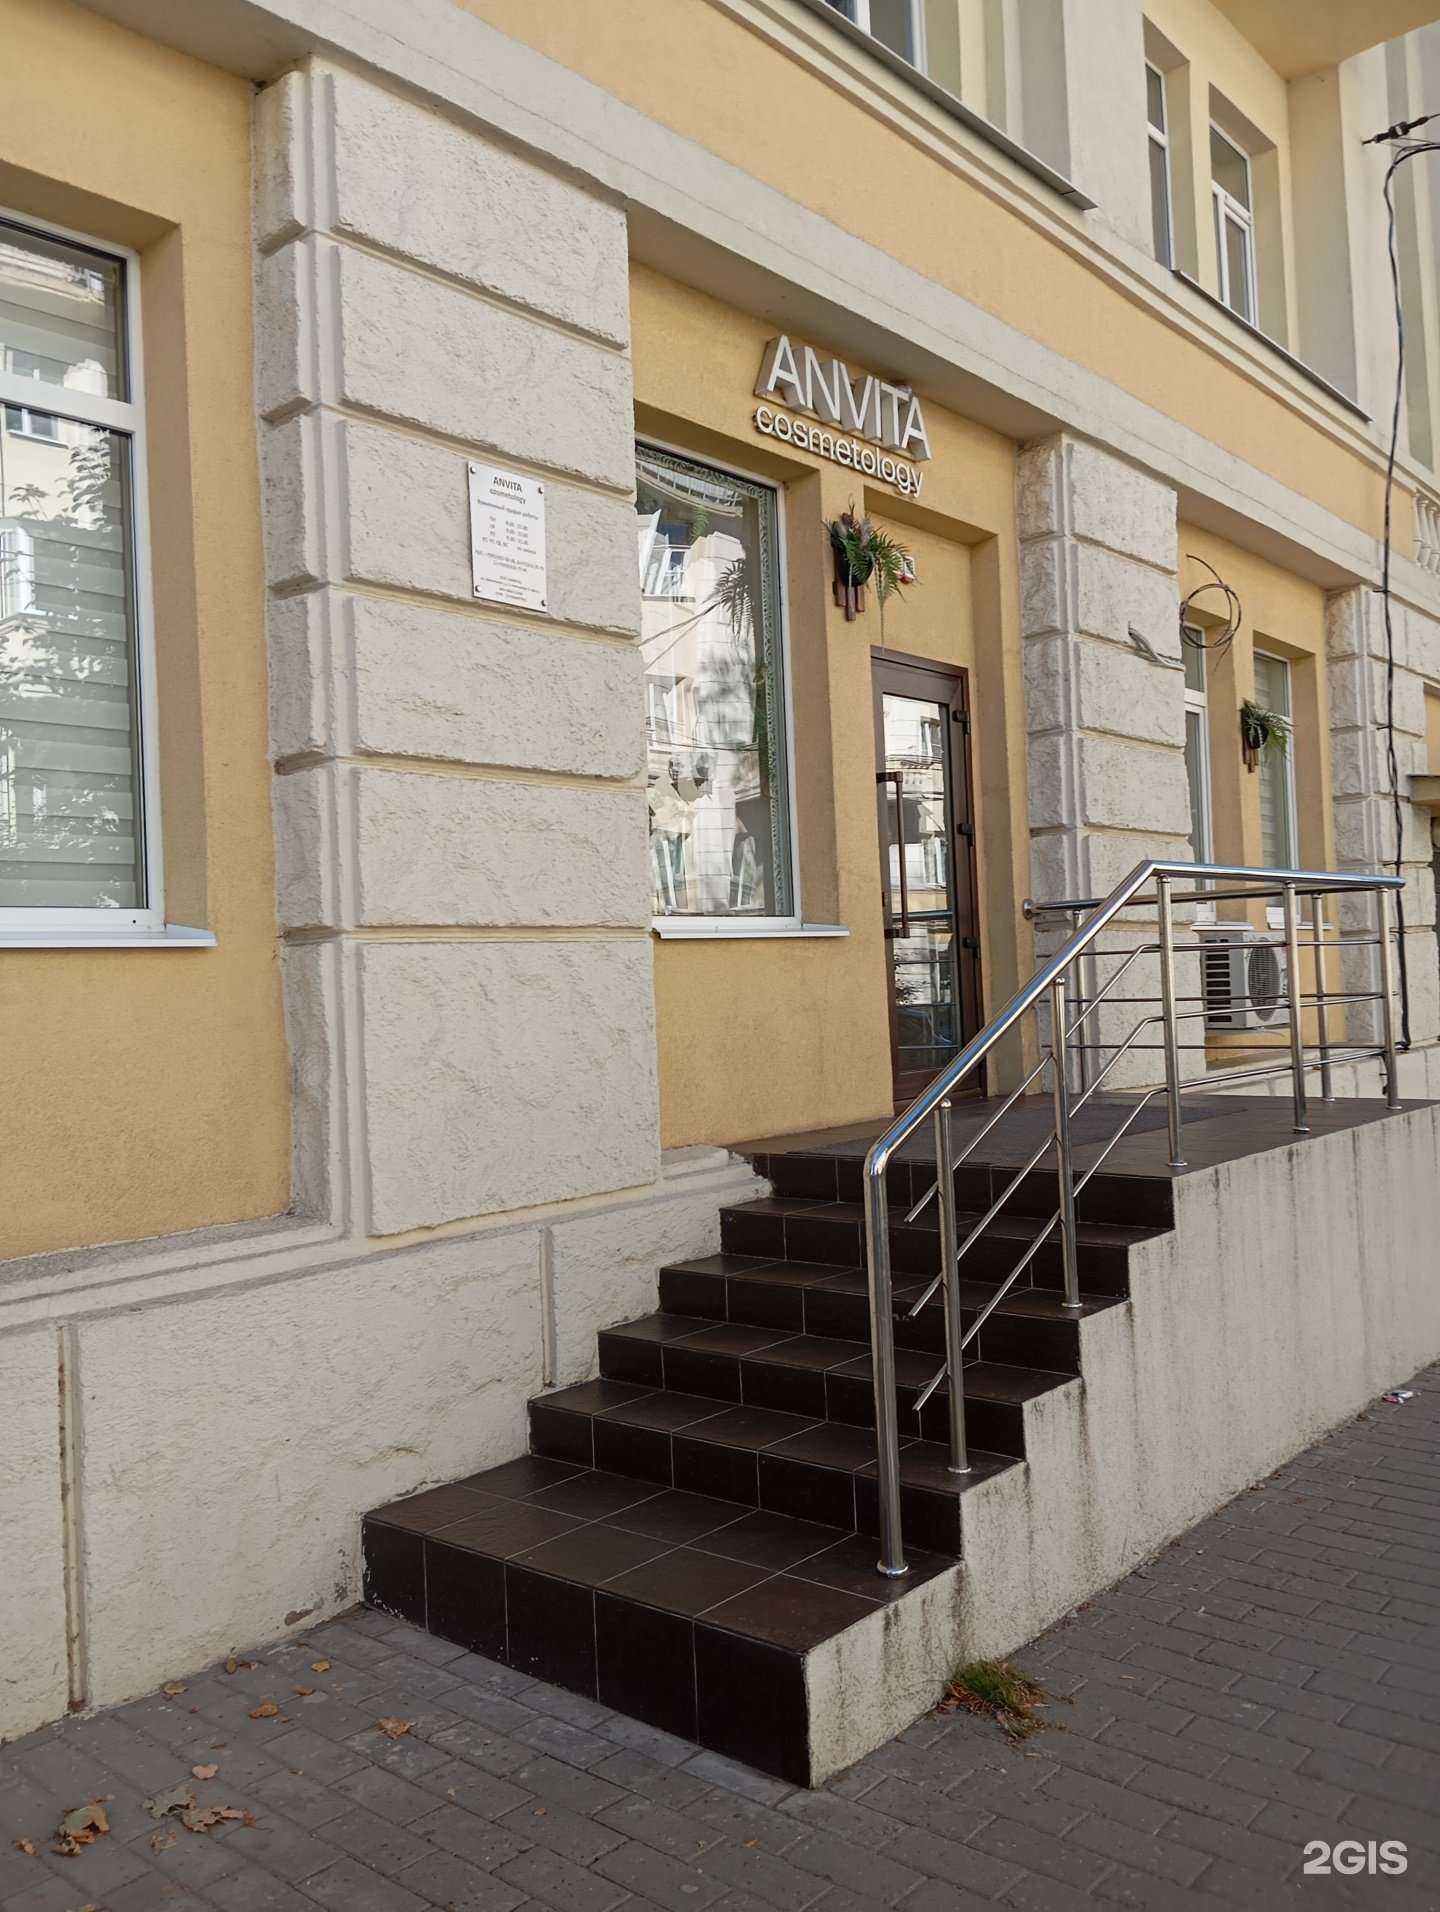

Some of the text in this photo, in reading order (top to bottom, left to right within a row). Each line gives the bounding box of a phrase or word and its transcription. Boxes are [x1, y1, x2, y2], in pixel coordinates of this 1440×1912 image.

[766, 334, 932, 460] ANVITA
[493, 476, 522, 492] ANVITA
[755, 406, 923, 498] cosmetology
